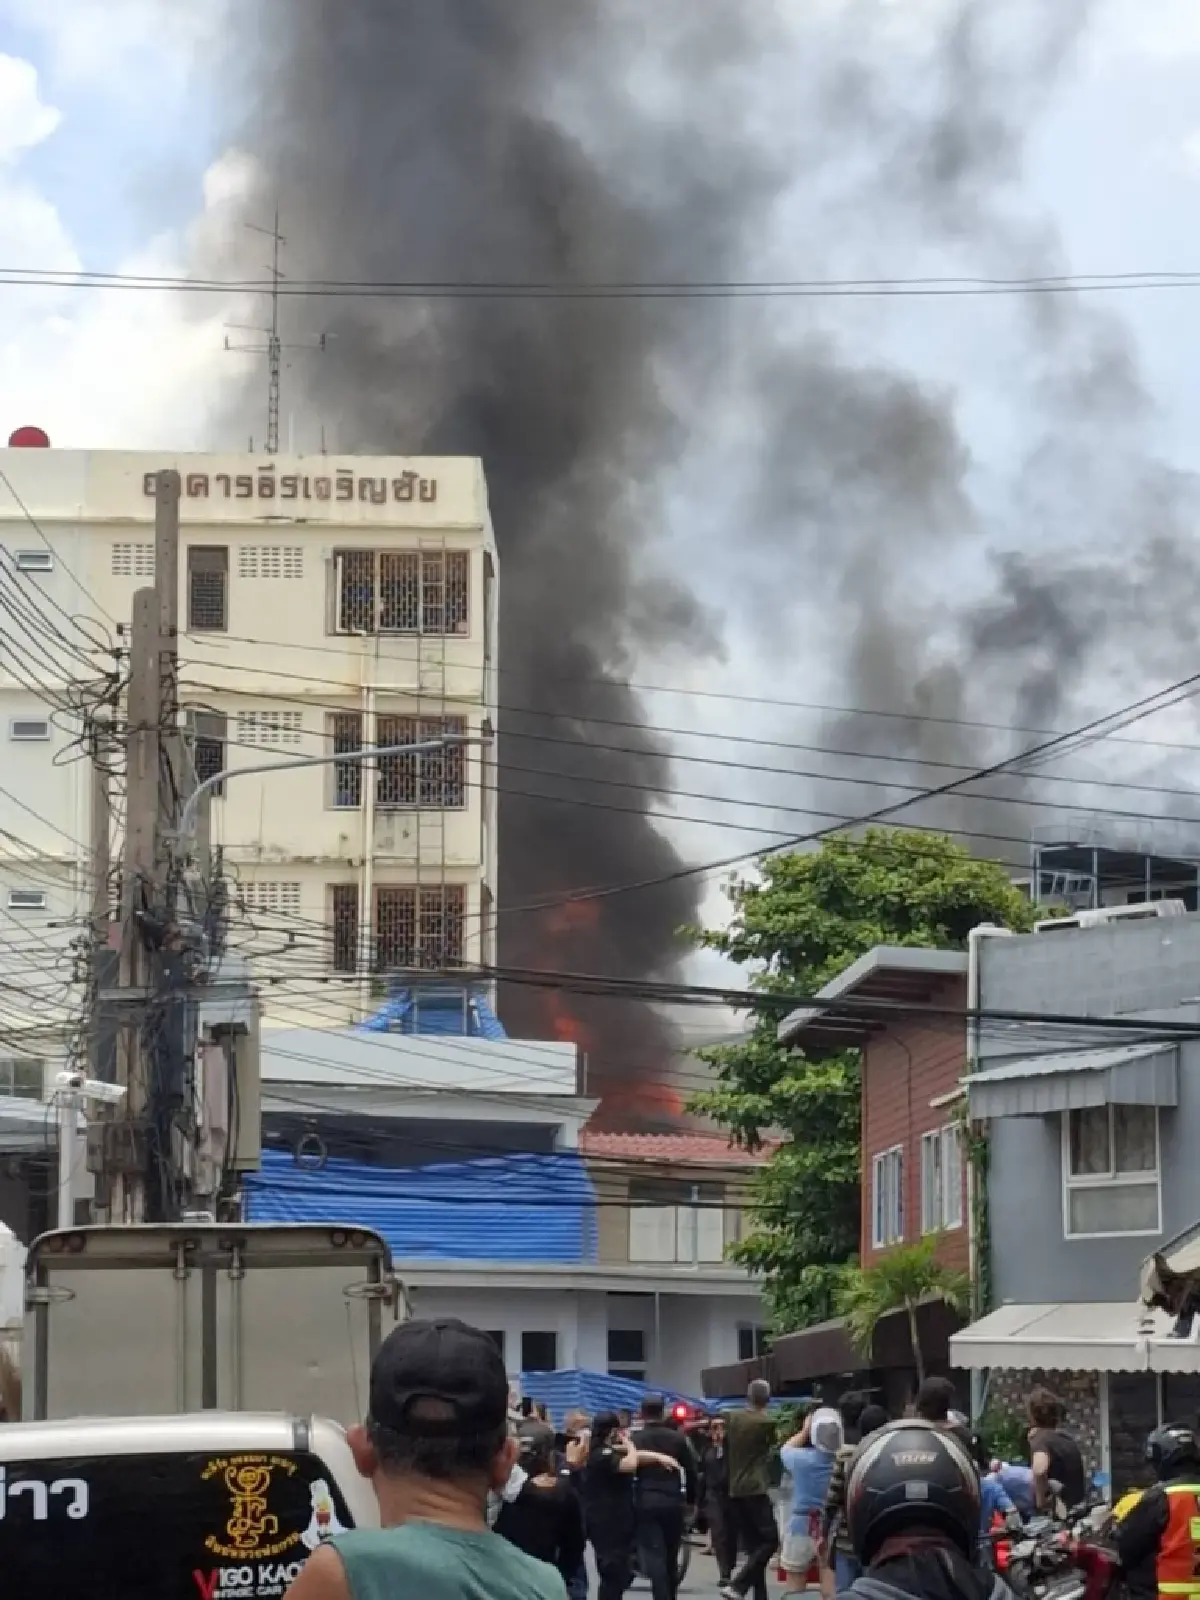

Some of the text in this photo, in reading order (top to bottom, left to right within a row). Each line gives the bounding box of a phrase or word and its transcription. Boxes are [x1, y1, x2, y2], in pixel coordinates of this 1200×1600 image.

[143, 464, 437, 504] อคารธีรเจริญชัย
[258, 1560, 306, 1585] KAO
